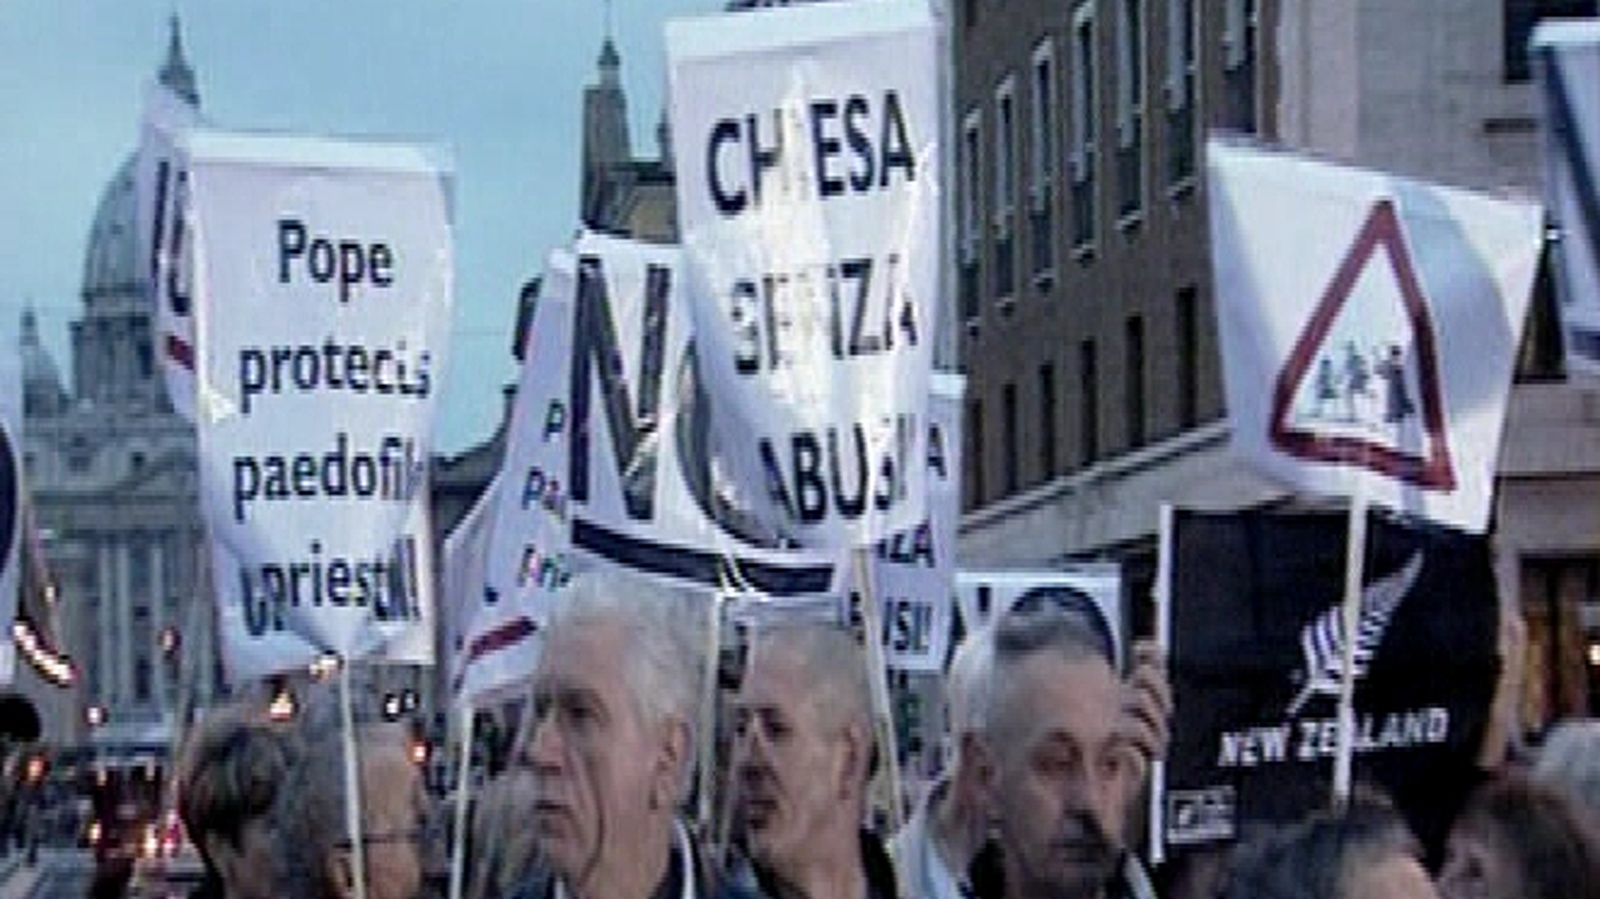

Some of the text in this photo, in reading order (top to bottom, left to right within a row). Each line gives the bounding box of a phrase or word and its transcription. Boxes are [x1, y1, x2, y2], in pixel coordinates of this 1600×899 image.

[705, 88, 916, 218] CHESA
[276, 218, 396, 303] Pope
[1217, 706, 1450, 767] NEW ZELAND
